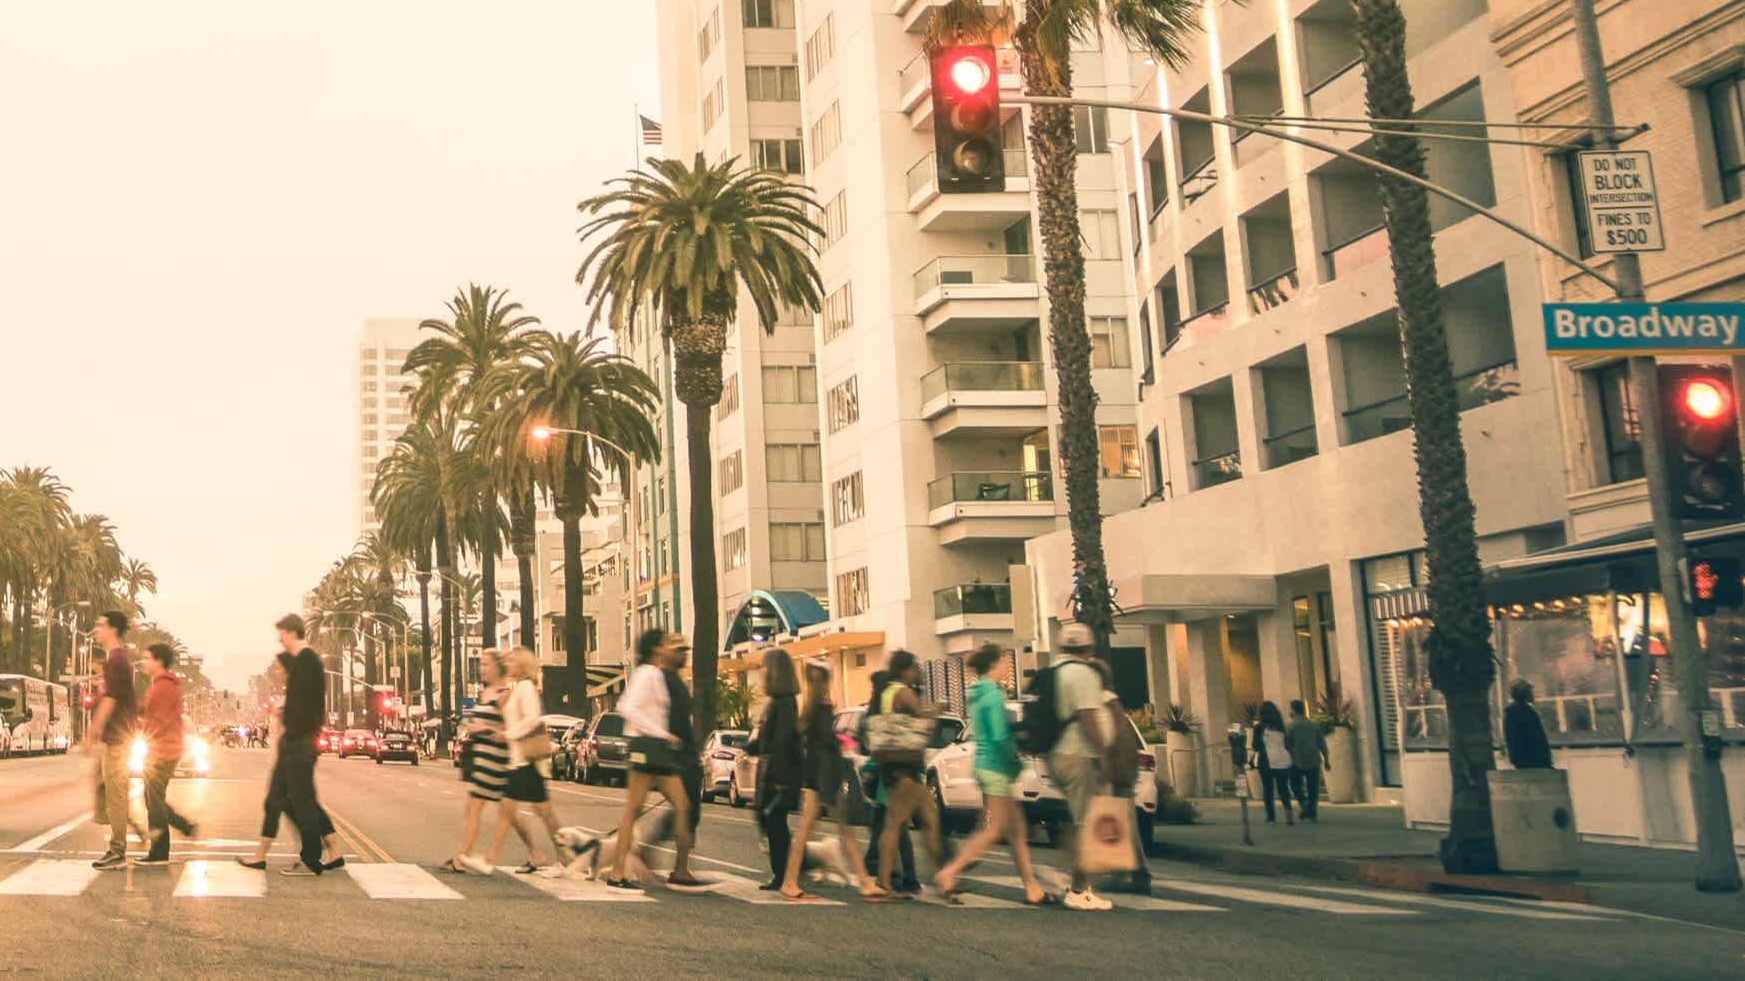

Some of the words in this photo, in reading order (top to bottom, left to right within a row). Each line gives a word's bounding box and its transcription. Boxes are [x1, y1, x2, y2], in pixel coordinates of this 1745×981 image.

[1594, 159, 1610, 172] DO
[1615, 158, 1636, 171] NOT
[1594, 174, 1642, 190] BLOCK
[1590, 193, 1654, 204] INTERSECTION
[1598, 213, 1632, 226] FINES
[1636, 212, 1651, 225] TO
[1607, 229, 1648, 246] $500
[1554, 306, 1740, 345] Broadway
